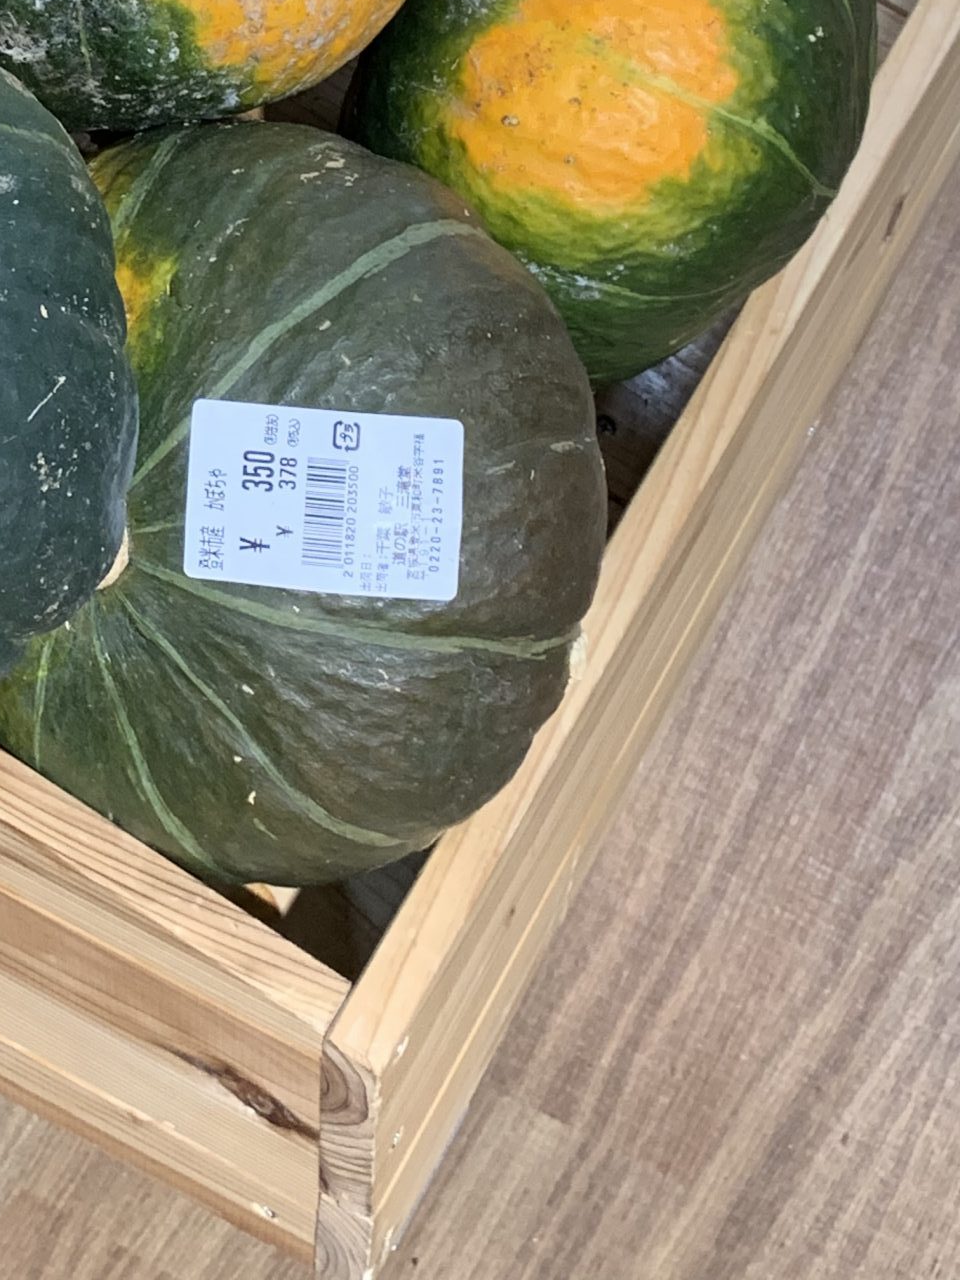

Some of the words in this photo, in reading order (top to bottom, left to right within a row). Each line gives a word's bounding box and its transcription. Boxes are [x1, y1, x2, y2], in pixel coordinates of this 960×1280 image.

[204, 469, 227, 511] かぼちゃ
[242, 450, 275, 492] 350
[279, 457, 297, 490] 378
[346, 466, 359, 513] 203500
[428, 459, 444, 572] 0220-23-7891
[199, 526, 225, 569] 登米市産
[240, 537, 270, 552] ¥
[344, 518, 356, 564] 011820
